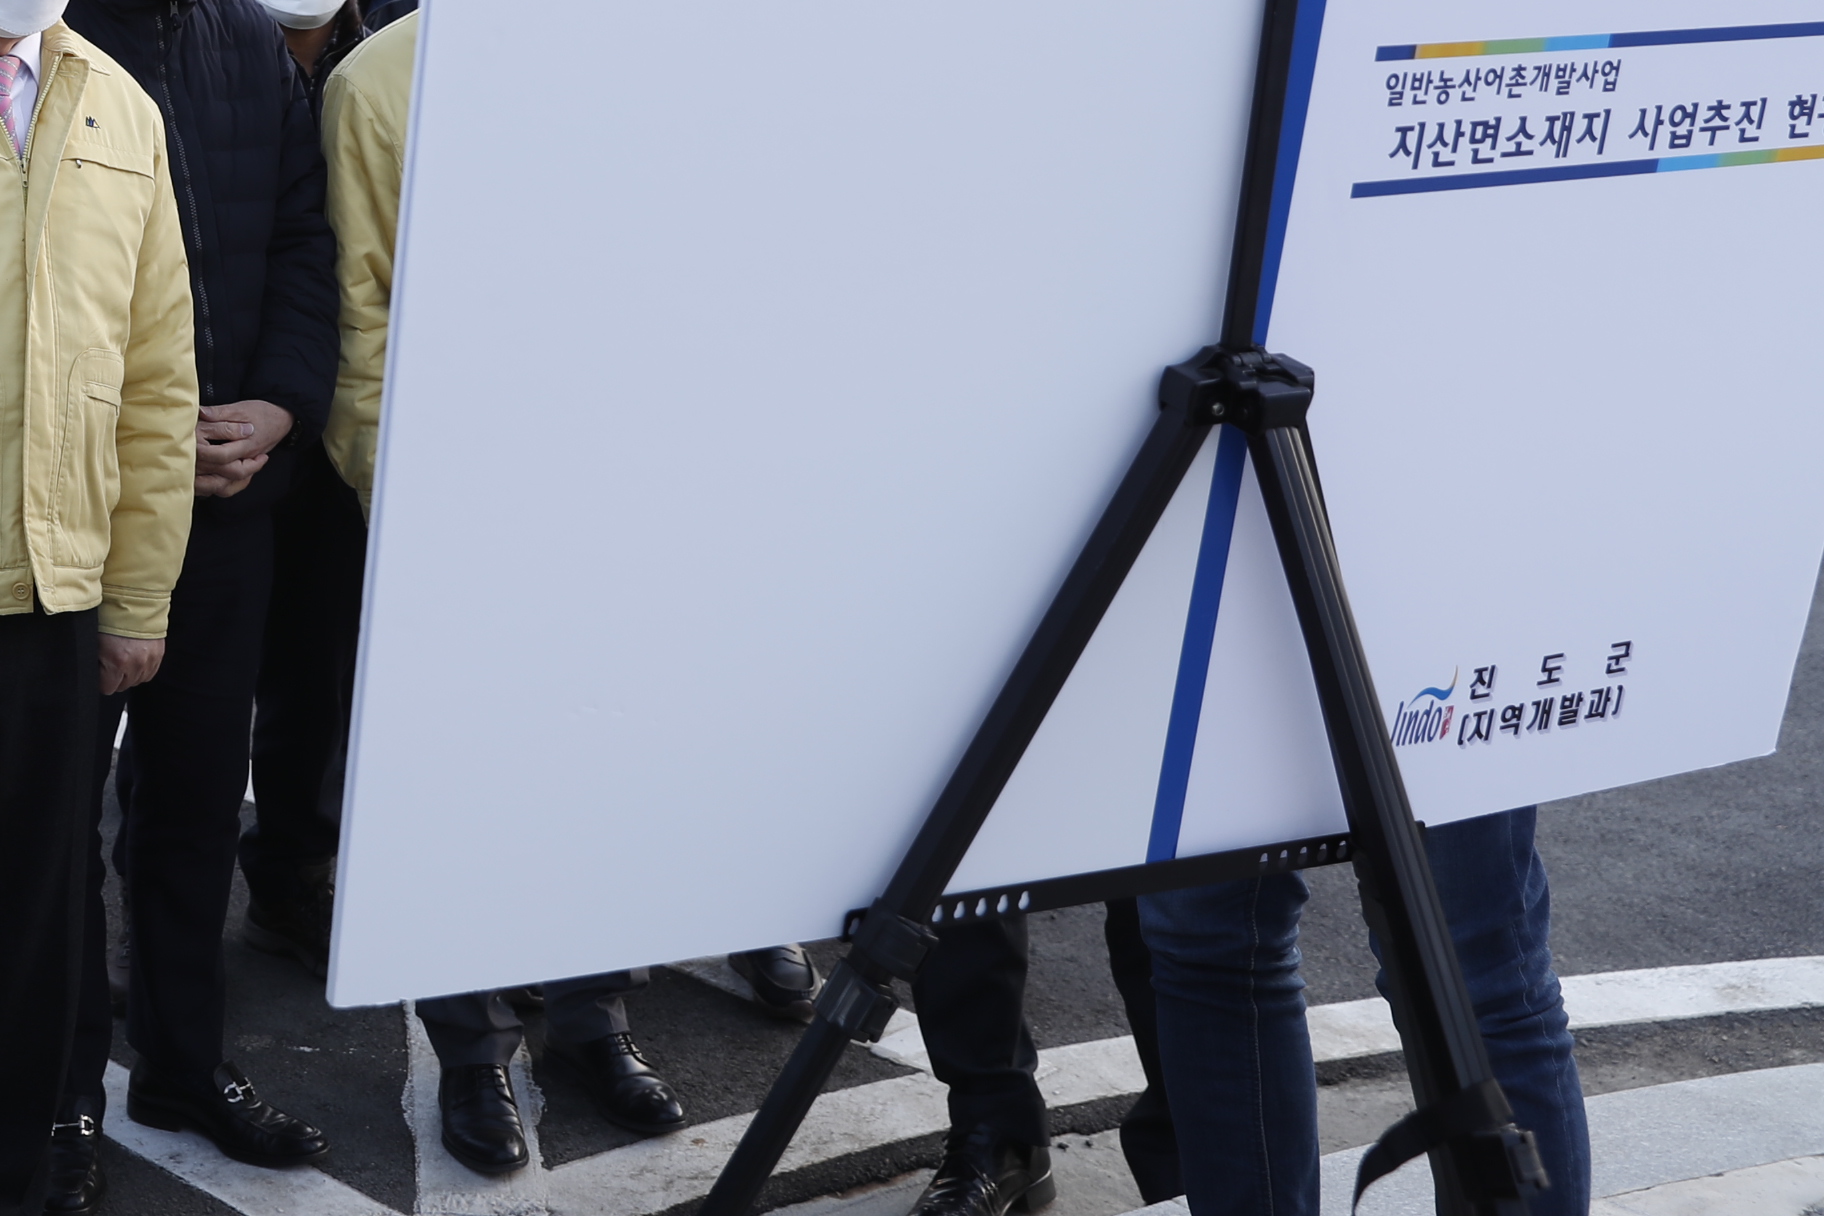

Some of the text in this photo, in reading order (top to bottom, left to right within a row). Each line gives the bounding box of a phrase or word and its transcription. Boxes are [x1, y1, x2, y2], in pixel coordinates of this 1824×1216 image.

[1384, 59, 1622, 107] 일반농산어촌개발사업
[1388, 93, 1824, 170] 지산면소재지 사업추진 현
